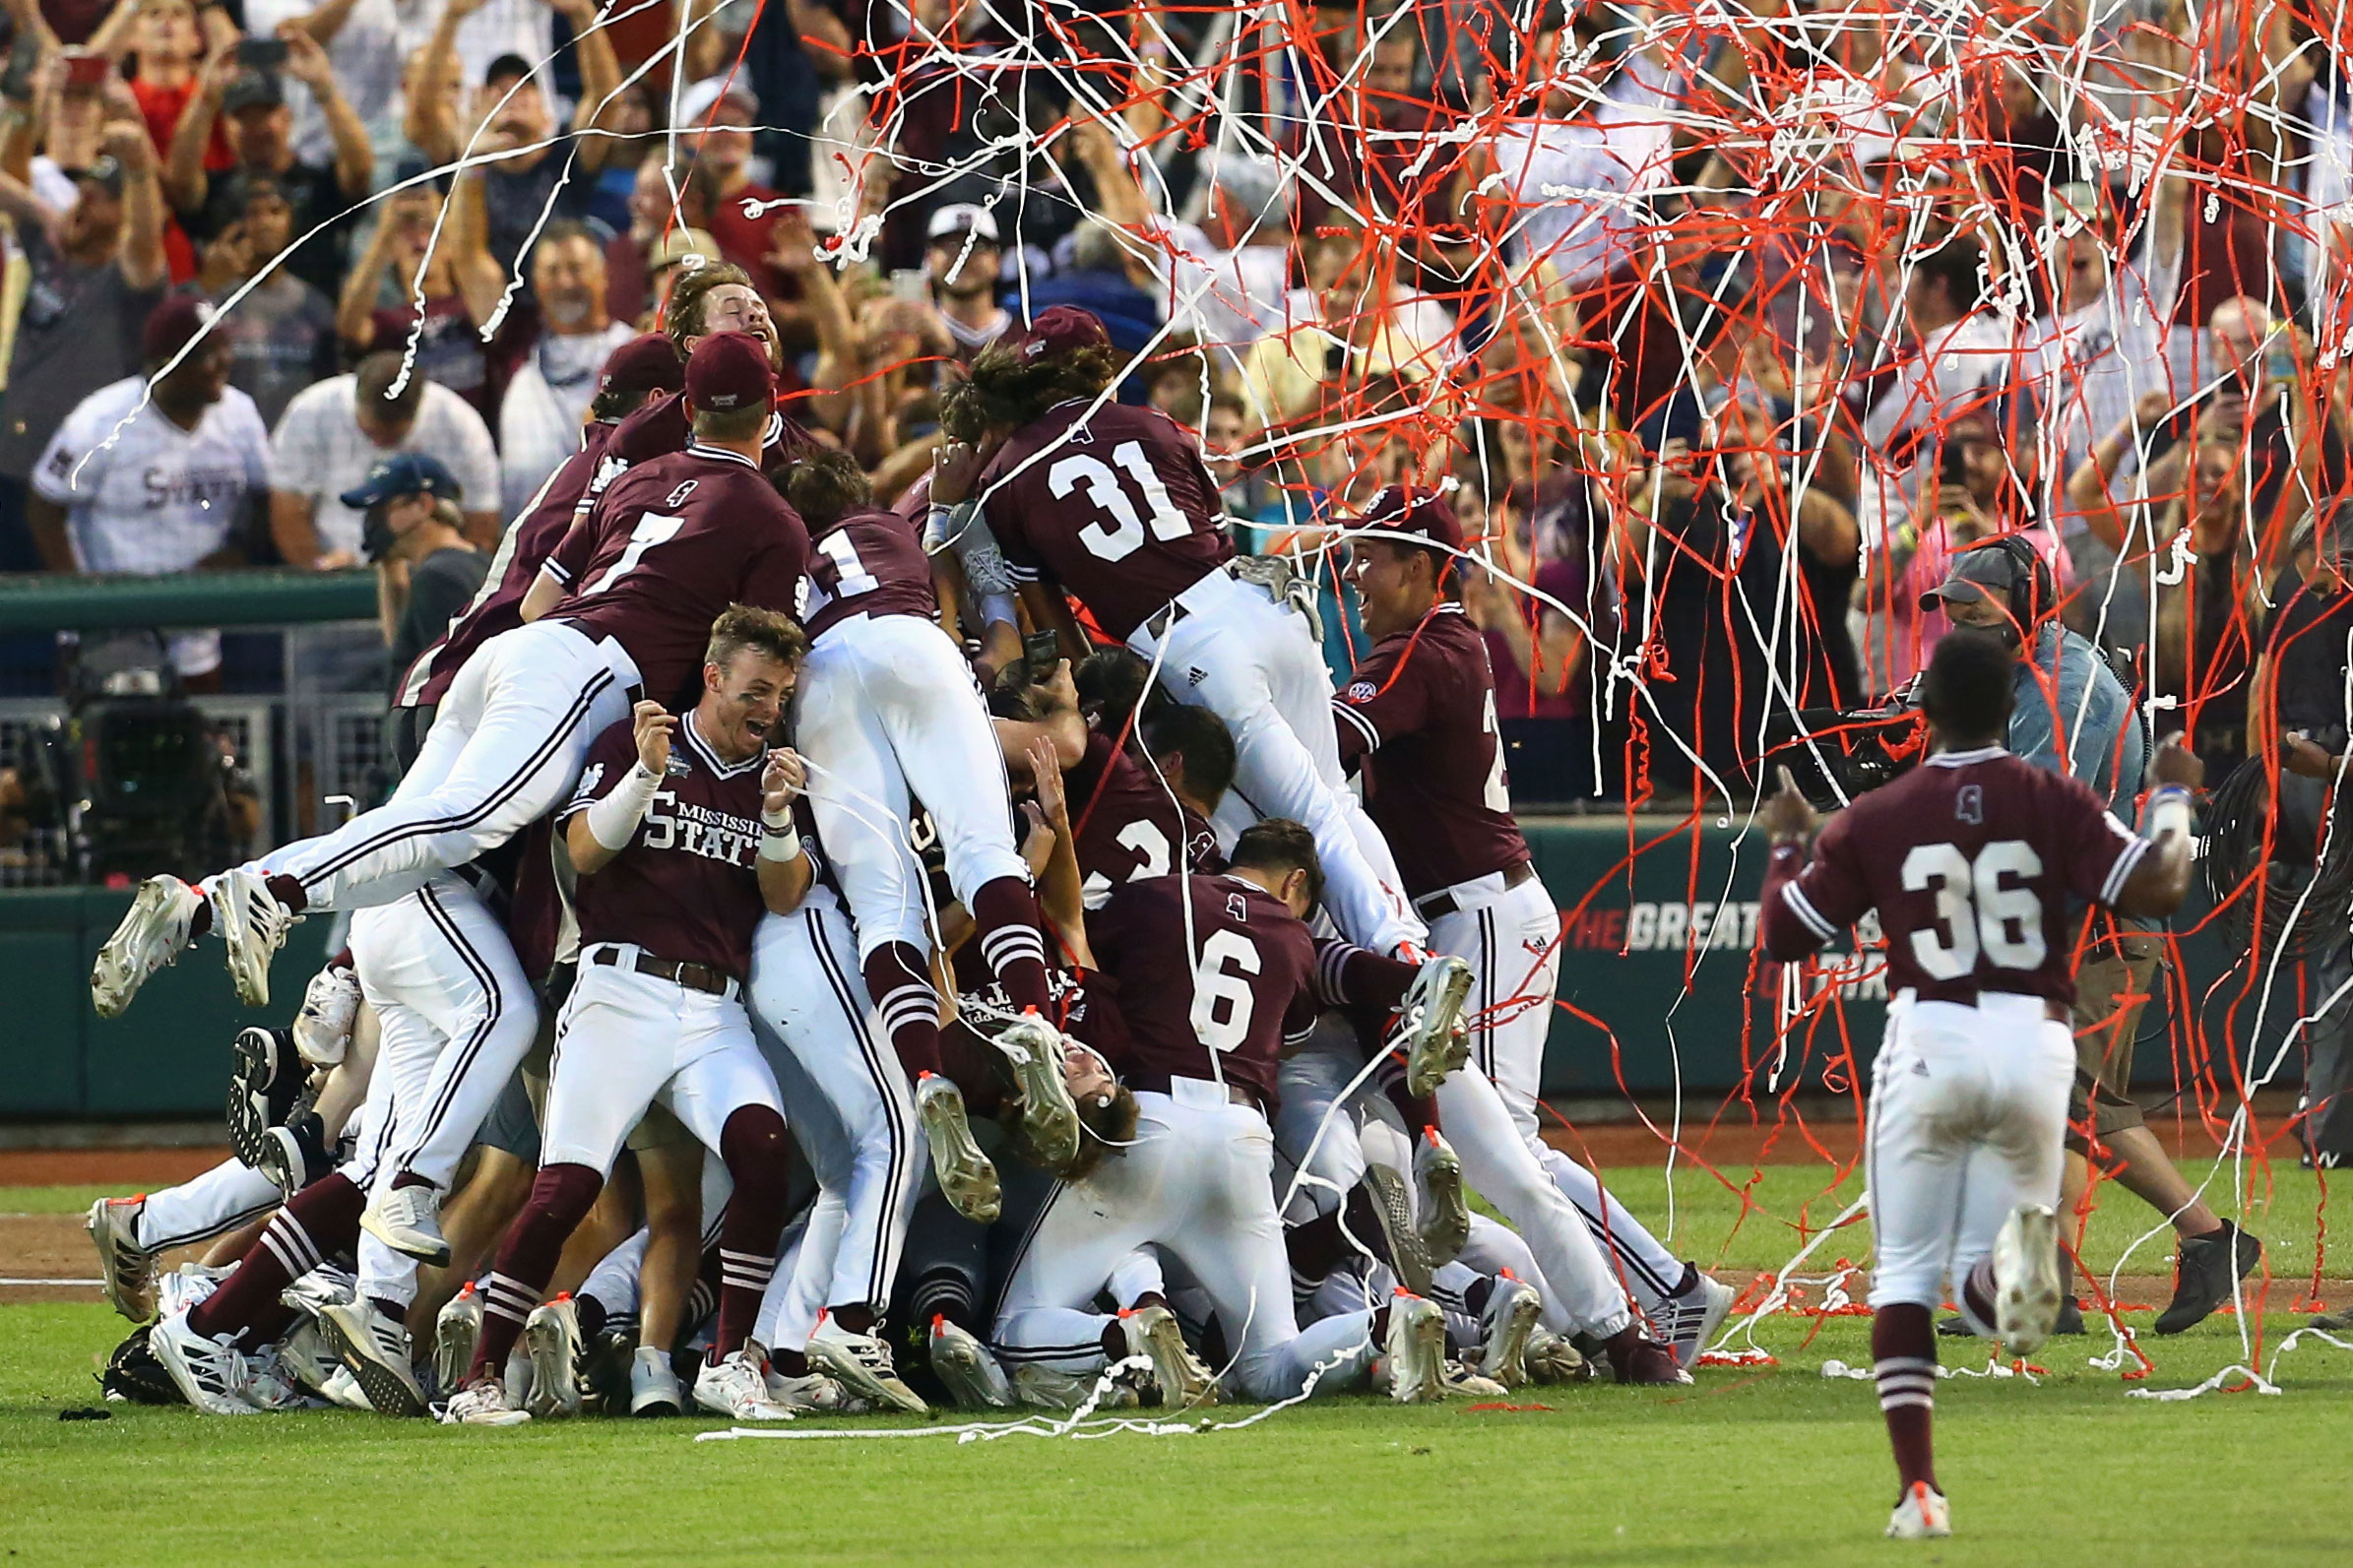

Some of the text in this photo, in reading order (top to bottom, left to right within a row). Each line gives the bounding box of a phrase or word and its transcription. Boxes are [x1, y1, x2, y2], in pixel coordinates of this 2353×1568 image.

[1048, 440, 1193, 563] 31
[581, 511, 685, 596] 7
[802, 529, 881, 624] 1
[643, 790, 764, 870] STAT
[677, 802, 763, 838] MISSISSI
[1628, 902, 1765, 951] GREAT
[1901, 840, 2047, 981] 36
[1189, 928, 1262, 1053] 6
